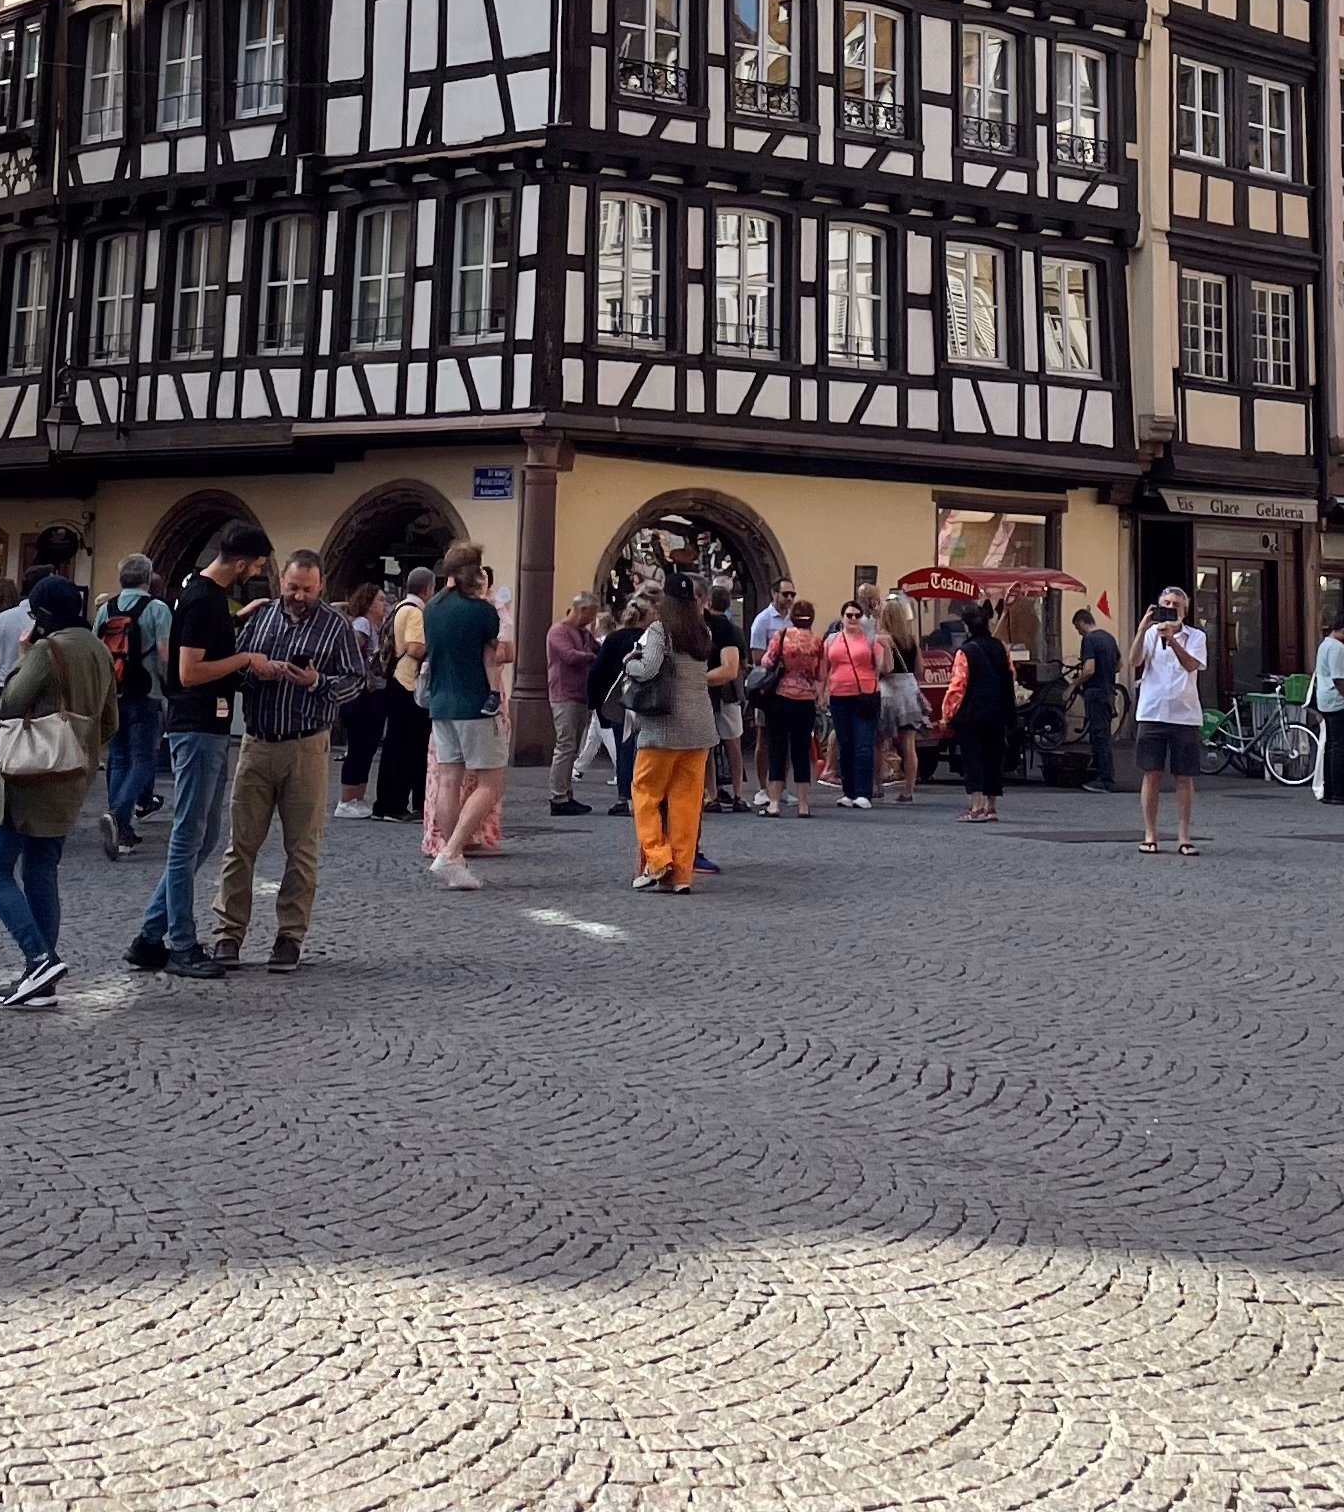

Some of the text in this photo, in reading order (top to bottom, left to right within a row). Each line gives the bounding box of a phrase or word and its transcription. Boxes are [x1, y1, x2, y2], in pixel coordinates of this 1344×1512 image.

[1176, 496, 1304, 520] Eis Glace Gelateria
